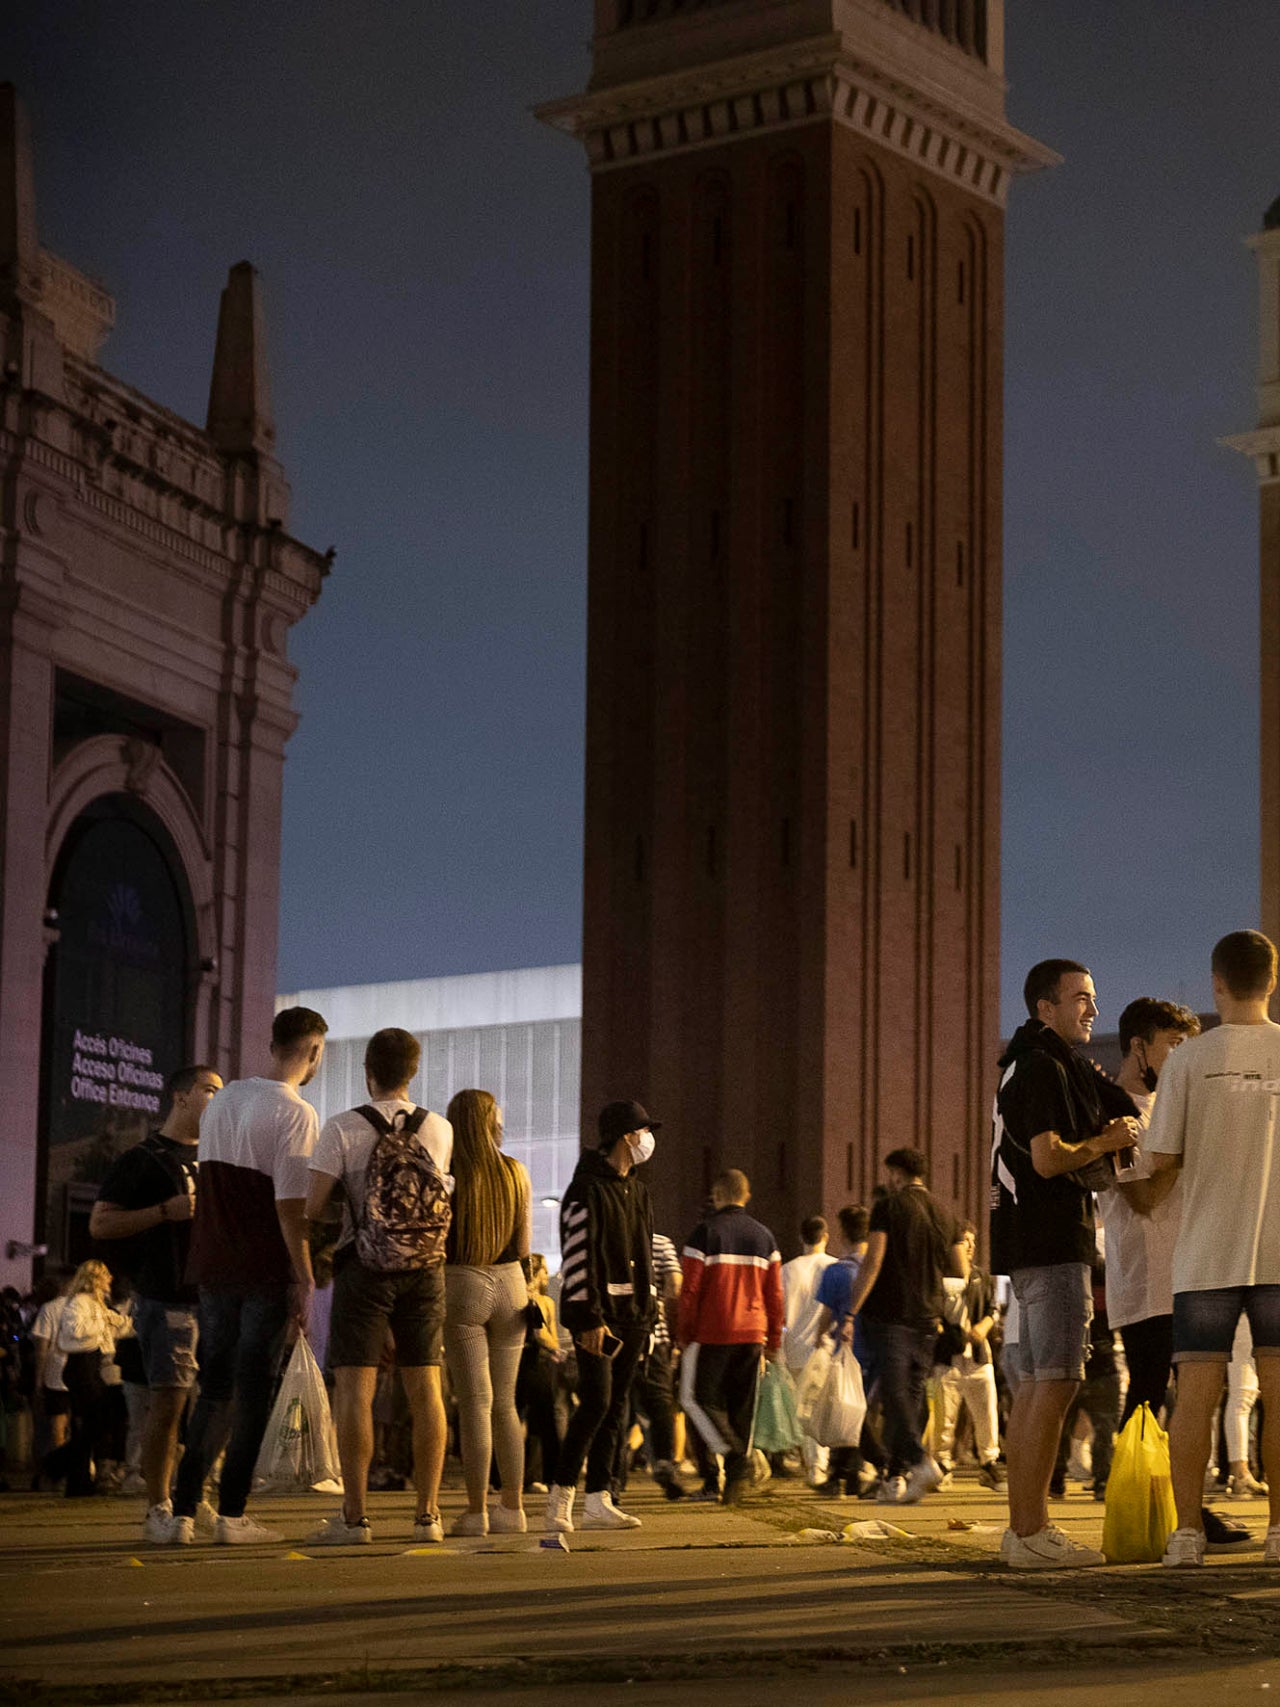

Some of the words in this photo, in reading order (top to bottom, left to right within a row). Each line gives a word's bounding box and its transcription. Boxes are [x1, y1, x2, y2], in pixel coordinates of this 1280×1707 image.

[109, 1037, 152, 1065] Oficines
[72, 1053, 116, 1080] Acceso
[118, 1061, 164, 1090] Oficinas
[71, 1076, 107, 1104] Office
[109, 1083, 160, 1112] Entrance
